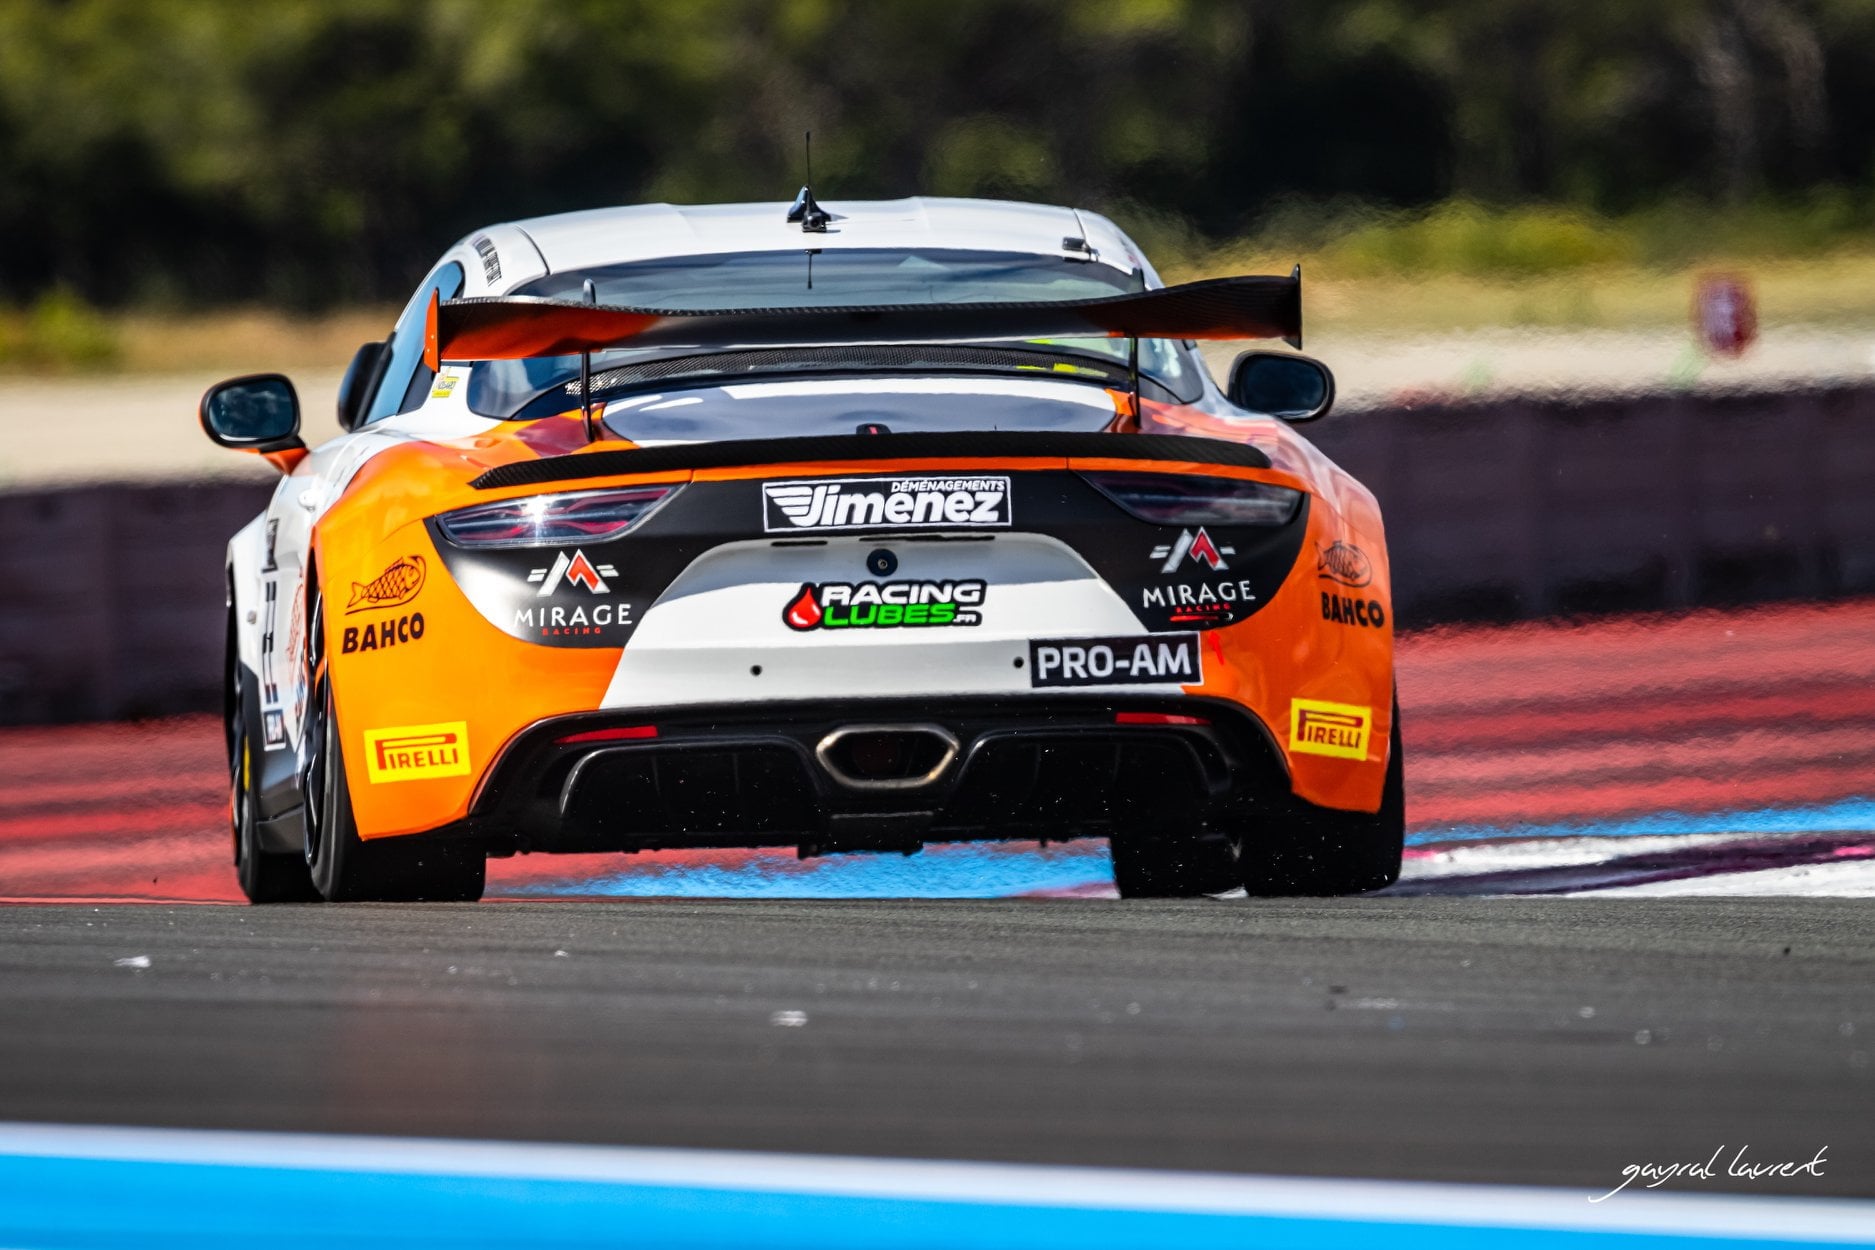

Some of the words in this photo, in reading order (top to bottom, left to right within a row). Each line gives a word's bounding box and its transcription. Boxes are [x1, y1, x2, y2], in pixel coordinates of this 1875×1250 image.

[891, 479, 1006, 493] DÉMÉNAGEMENTS
[766, 484, 1004, 527] Jimenez
[821, 583, 982, 607] RACING
[1142, 580, 1256, 608] MIRAGE
[1175, 602, 1231, 614] RACING
[1320, 591, 1385, 628] BAHCO
[514, 603, 633, 628] MIRAGE
[541, 626, 602, 636] RACING
[341, 612, 425, 655] BAHCO
[1037, 642, 1192, 680] PRO-AM
[1297, 708, 1364, 750] PIRELLI
[374, 732, 460, 771] PIRELLI
